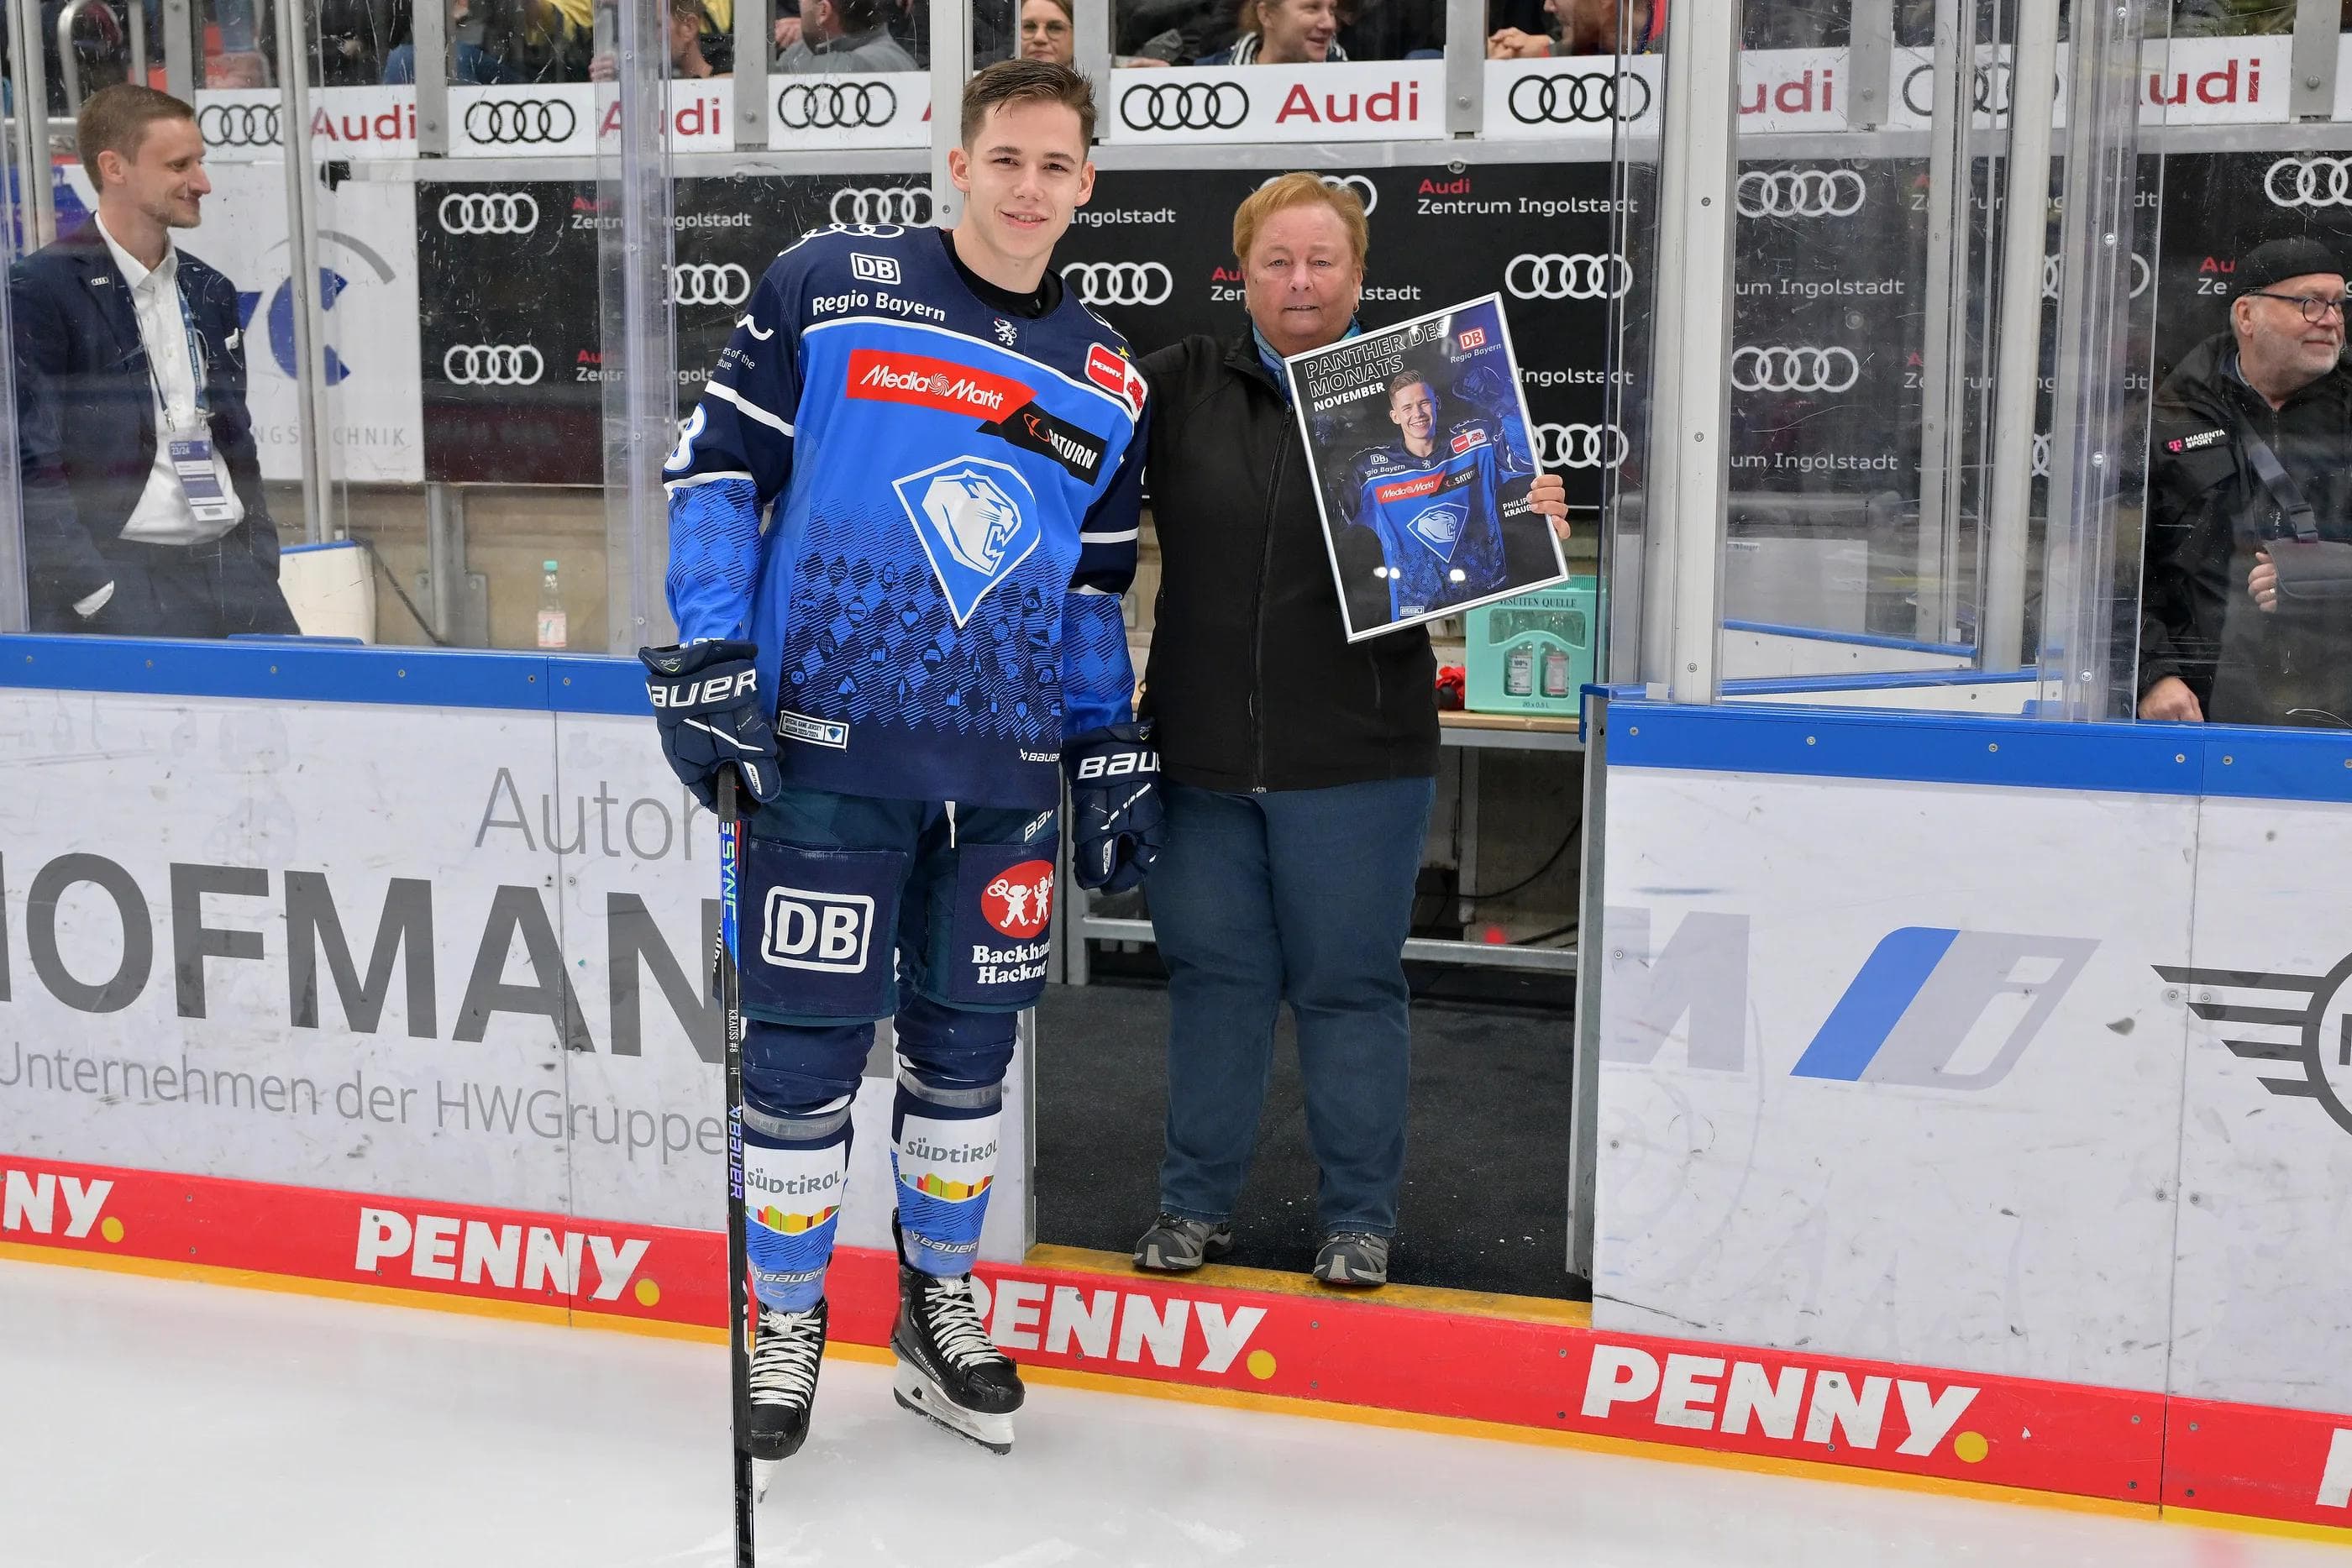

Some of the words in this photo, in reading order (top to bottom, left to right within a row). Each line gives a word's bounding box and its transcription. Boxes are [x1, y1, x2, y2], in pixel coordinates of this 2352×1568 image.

[1737, 69, 1833, 114] udi
[2139, 58, 2260, 107] udi
[1275, 81, 1419, 124] Audi
[310, 103, 417, 141] Audi
[1418, 177, 1472, 195] Audi
[1069, 207, 1177, 228] Ingolstadt
[1417, 198, 1512, 215] Zentrum
[1518, 197, 1639, 217] Ingolstadt
[856, 258, 896, 281] DB
[1779, 277, 1905, 299] Ingolstadt
[812, 289, 869, 317] Regio
[876, 292, 946, 322] Bayern
[1304, 334, 1407, 380] PANTHER
[1409, 319, 1446, 347] DES
[1461, 330, 1484, 349] DB
[742, 354, 755, 370] the
[1450, 351, 1473, 364] Regio
[1473, 343, 1502, 358] Bayern
[1308, 354, 1404, 398] MONATS
[1313, 381, 1386, 412] NOVEMBER
[2185, 428, 2226, 442] MAGENTA
[2186, 438, 2213, 449] SPORT
[1048, 427, 1099, 470] SATURN
[1380, 464, 1405, 474] Bayern
[1773, 452, 1899, 473] Ingolstadt
[1502, 496, 1529, 511] PHILIP
[1542, 598, 1577, 608] QUELLE
[1027, 752, 1060, 763] BAUER
[774, 899, 860, 960] DB
[728, 1008, 739, 1041] KRAUSS
[728, 1041, 739, 1053] #8
[336, 1070, 417, 1124] der
[436, 1080, 723, 1165] HWGruppe
[728, 1121, 744, 1200] BAUER
[921, 1235, 977, 1254] BAUER
[762, 1266, 825, 1283] BAUER
